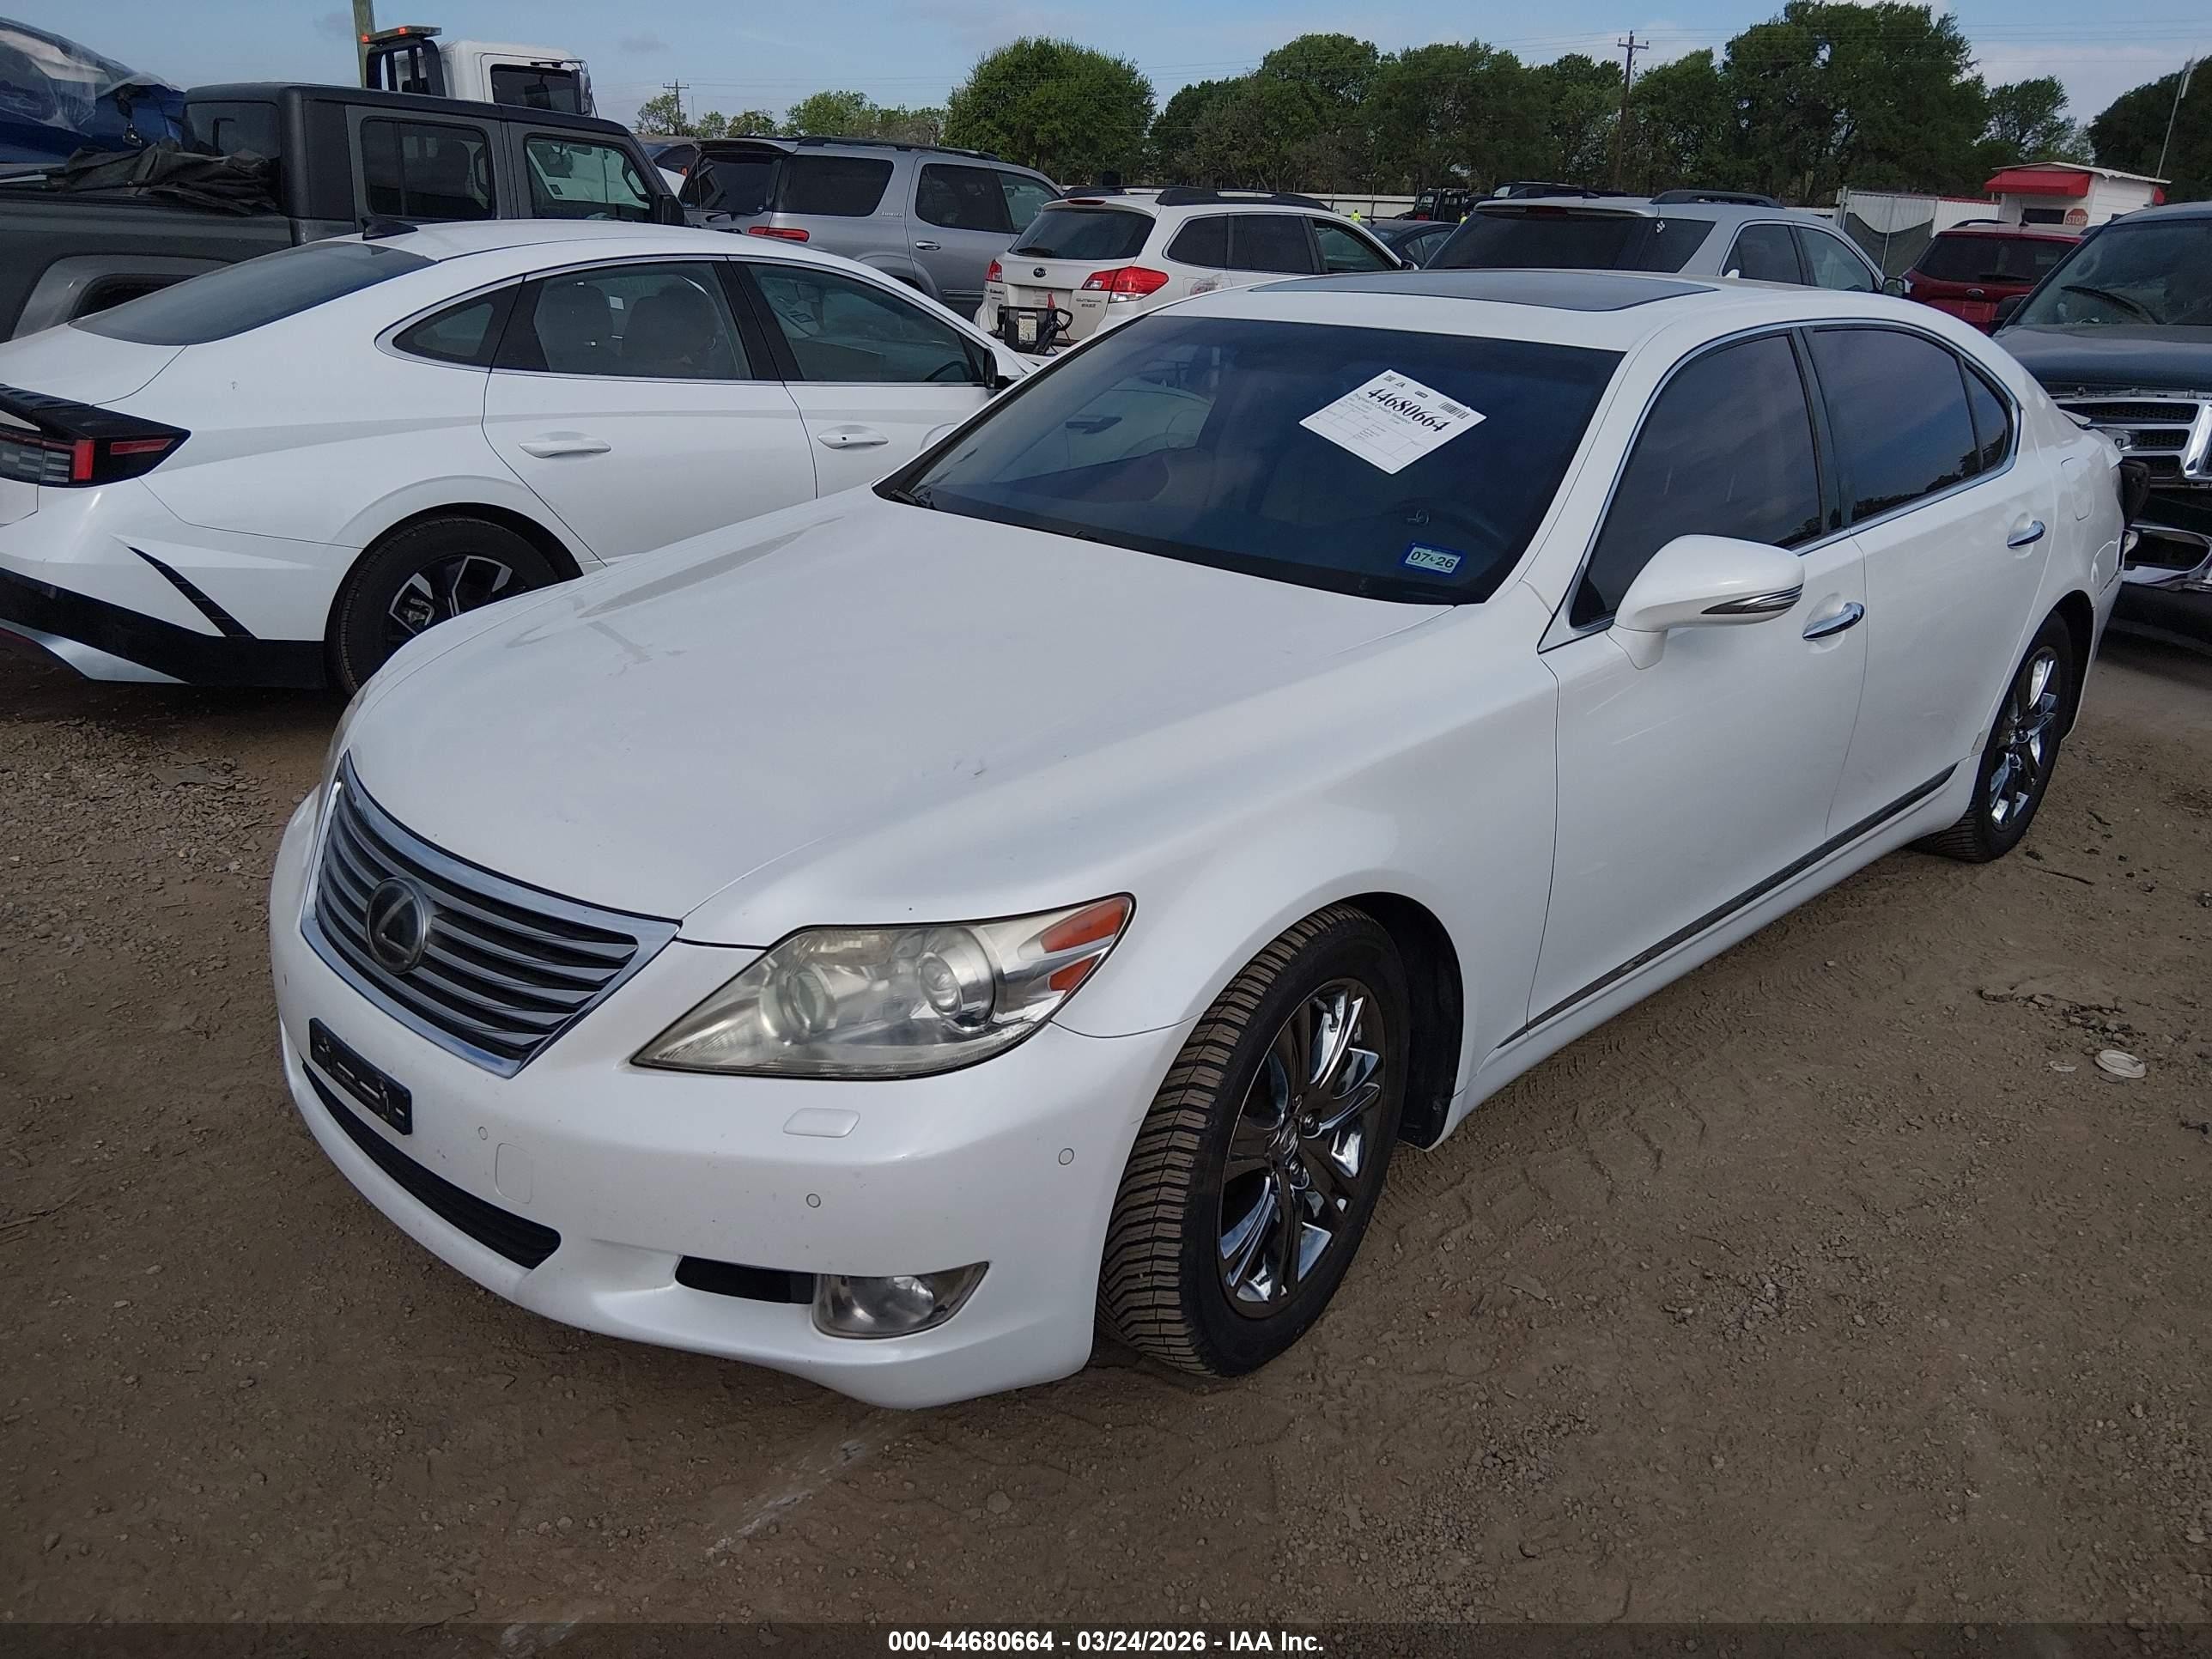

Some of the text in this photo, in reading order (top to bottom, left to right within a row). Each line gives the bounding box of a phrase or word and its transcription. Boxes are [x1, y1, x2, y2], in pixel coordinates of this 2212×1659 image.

[2066, 215, 2087, 224] STOP
[1367, 388, 1451, 432] 44680664
[1410, 551, 1456, 568] 07 26
